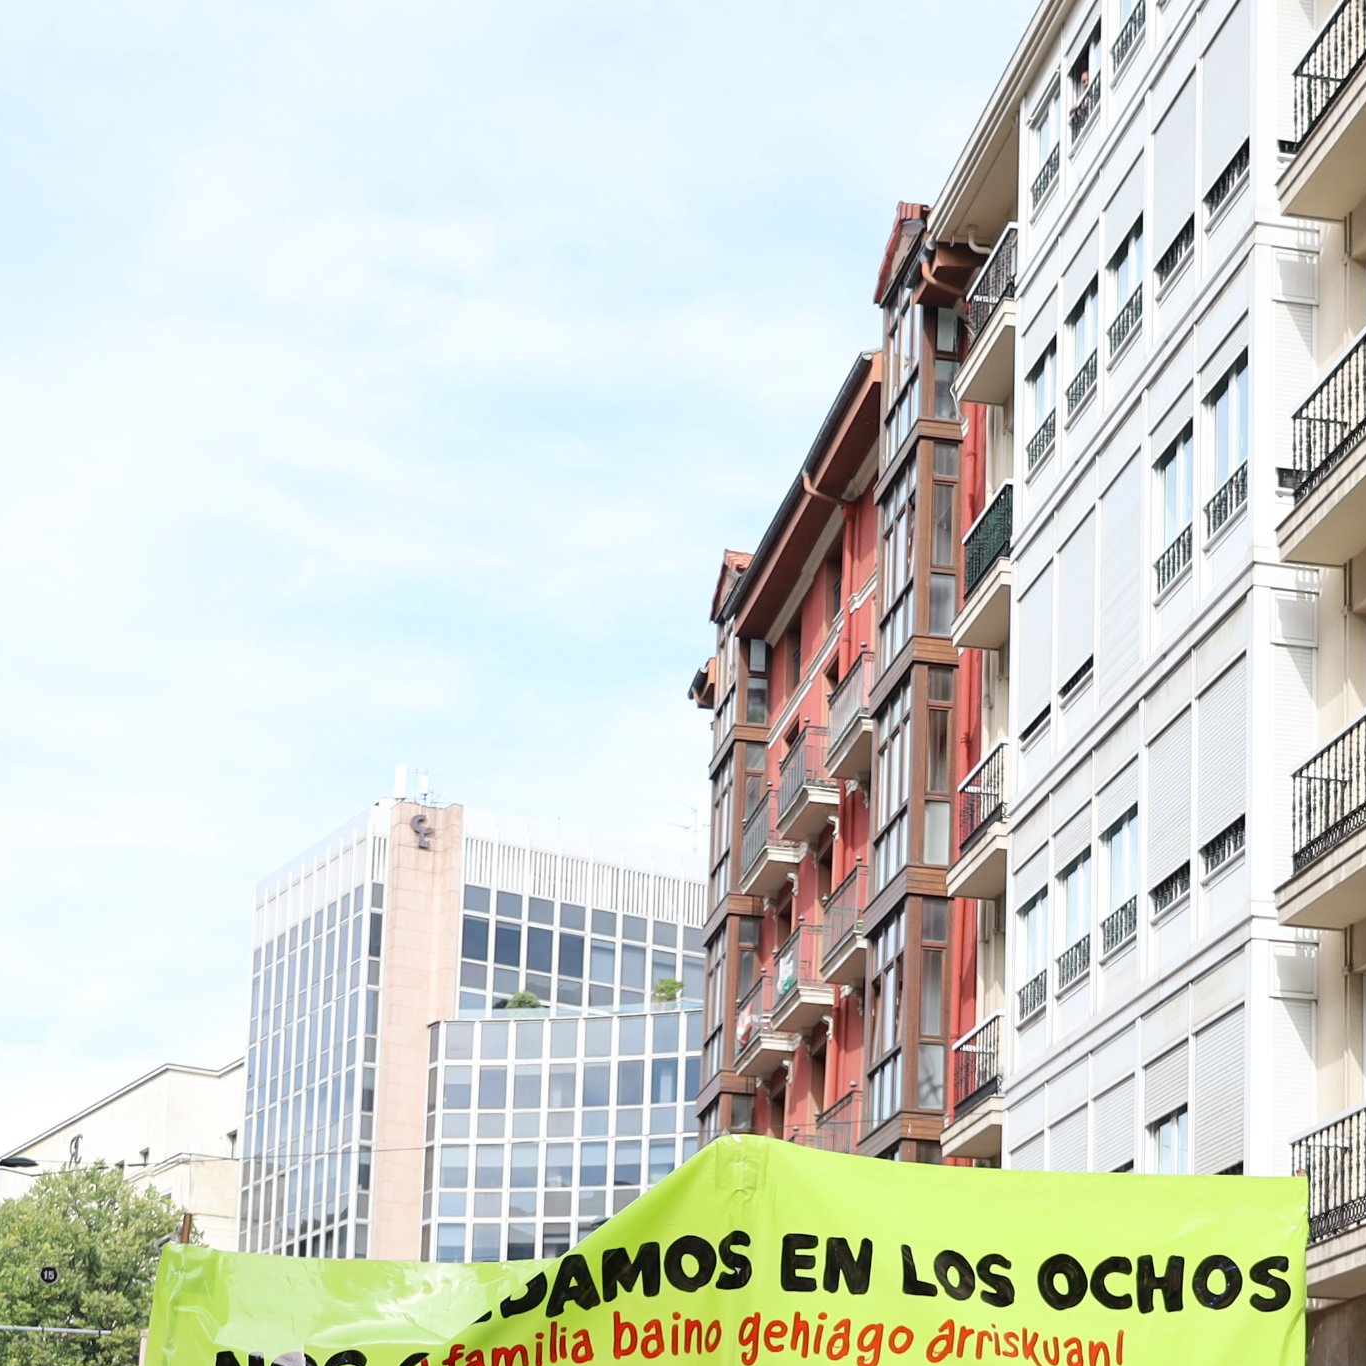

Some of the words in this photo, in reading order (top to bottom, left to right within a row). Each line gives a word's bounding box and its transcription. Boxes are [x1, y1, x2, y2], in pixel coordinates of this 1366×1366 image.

[43, 1271, 55, 1280] 15
[781, 1233, 873, 1295] EN
[901, 1244, 1015, 1308] LOS
[1037, 1253, 1292, 1314] OCHOS
[613, 1311, 722, 1360] baino
